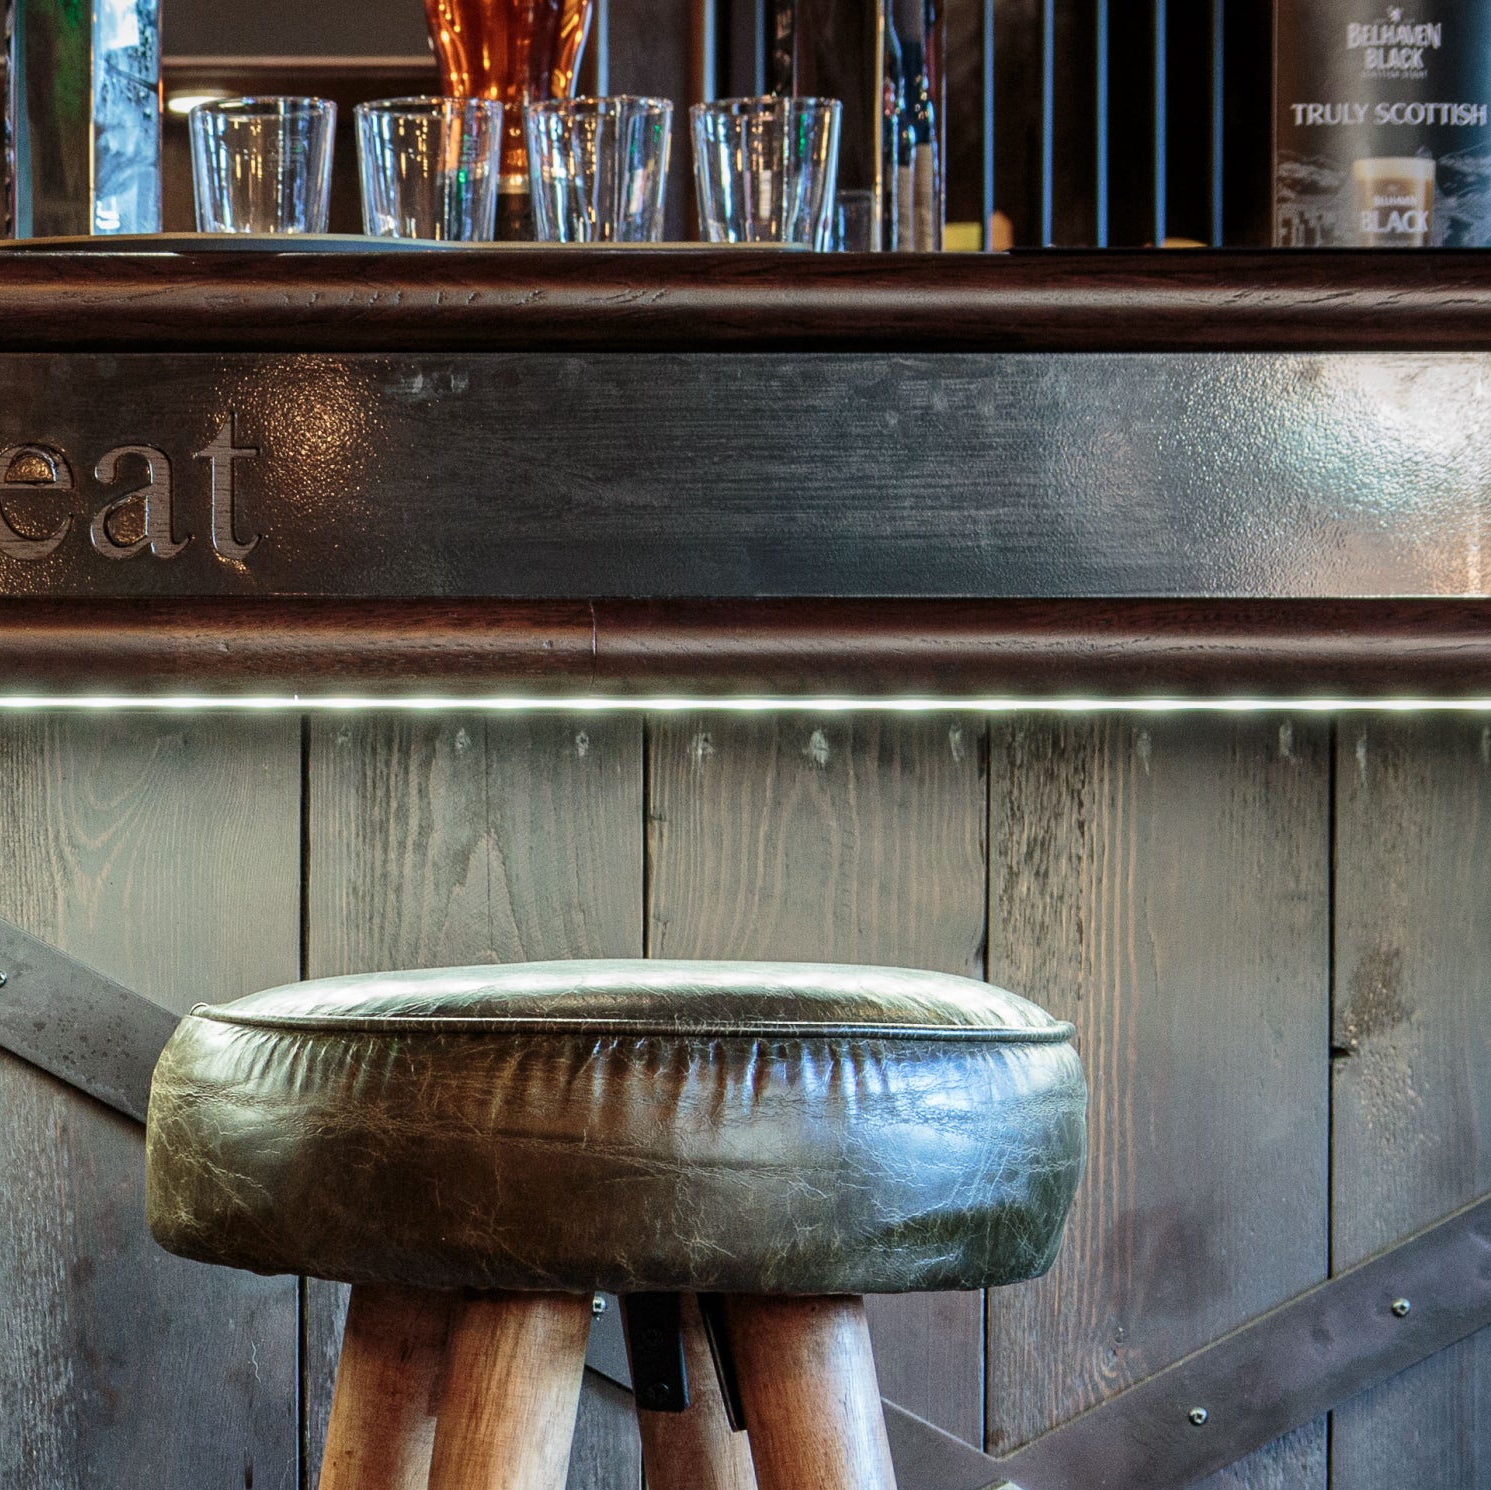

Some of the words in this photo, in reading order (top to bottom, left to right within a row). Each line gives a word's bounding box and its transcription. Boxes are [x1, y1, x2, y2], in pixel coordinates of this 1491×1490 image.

[1346, 22, 1442, 49] BELHAVEN
[1364, 47, 1424, 70] BLACK
[1290, 103, 1369, 126] TRULY
[1374, 102, 1487, 126] SCOTTISH
[1361, 210, 1429, 233] BLACK
